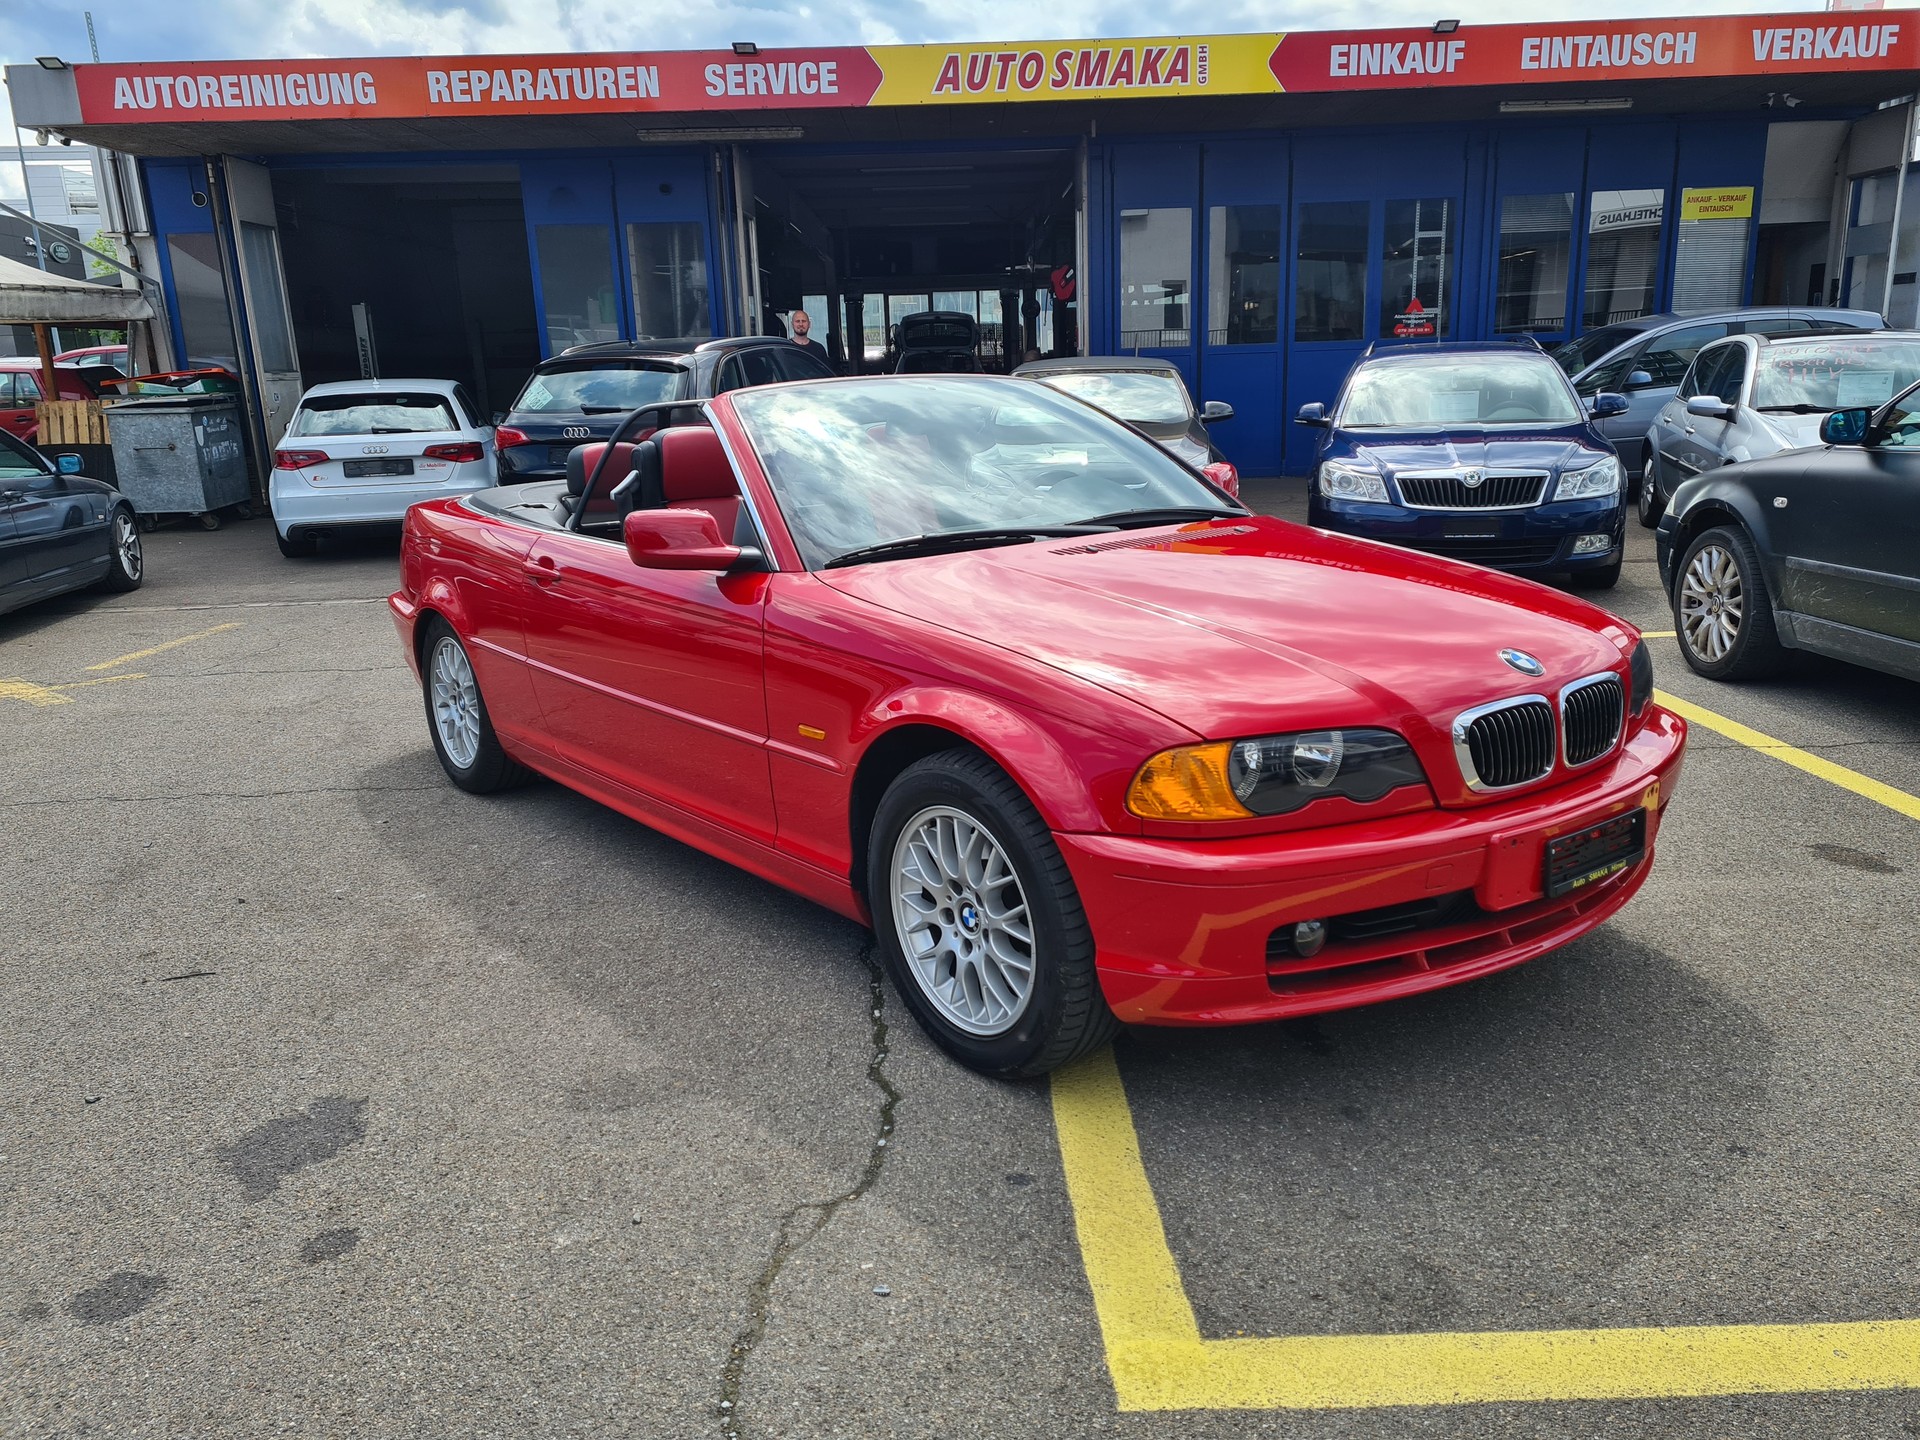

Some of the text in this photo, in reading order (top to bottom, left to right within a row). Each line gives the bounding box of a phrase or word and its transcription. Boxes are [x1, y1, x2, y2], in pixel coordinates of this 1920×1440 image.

[1330, 40, 1466, 77] EINKAUF
[1521, 31, 1697, 70] EINTAUSCH
[1752, 24, 1900, 61] VERKAUF
[704, 60, 839, 98] SERVICE
[932, 44, 1193, 95] AUTO SMAKA
[1196, 44, 1209, 85] GMBH
[114, 71, 377, 110] AUTOREINIGUNG
[427, 65, 660, 103] REPARATUREN
[1699, 205, 1734, 213] EINTAUSCH
[1719, 194, 1747, 202] VERKAUF
[1573, 878, 1586, 888] Auto
[1589, 868, 1608, 881] SMAKA
